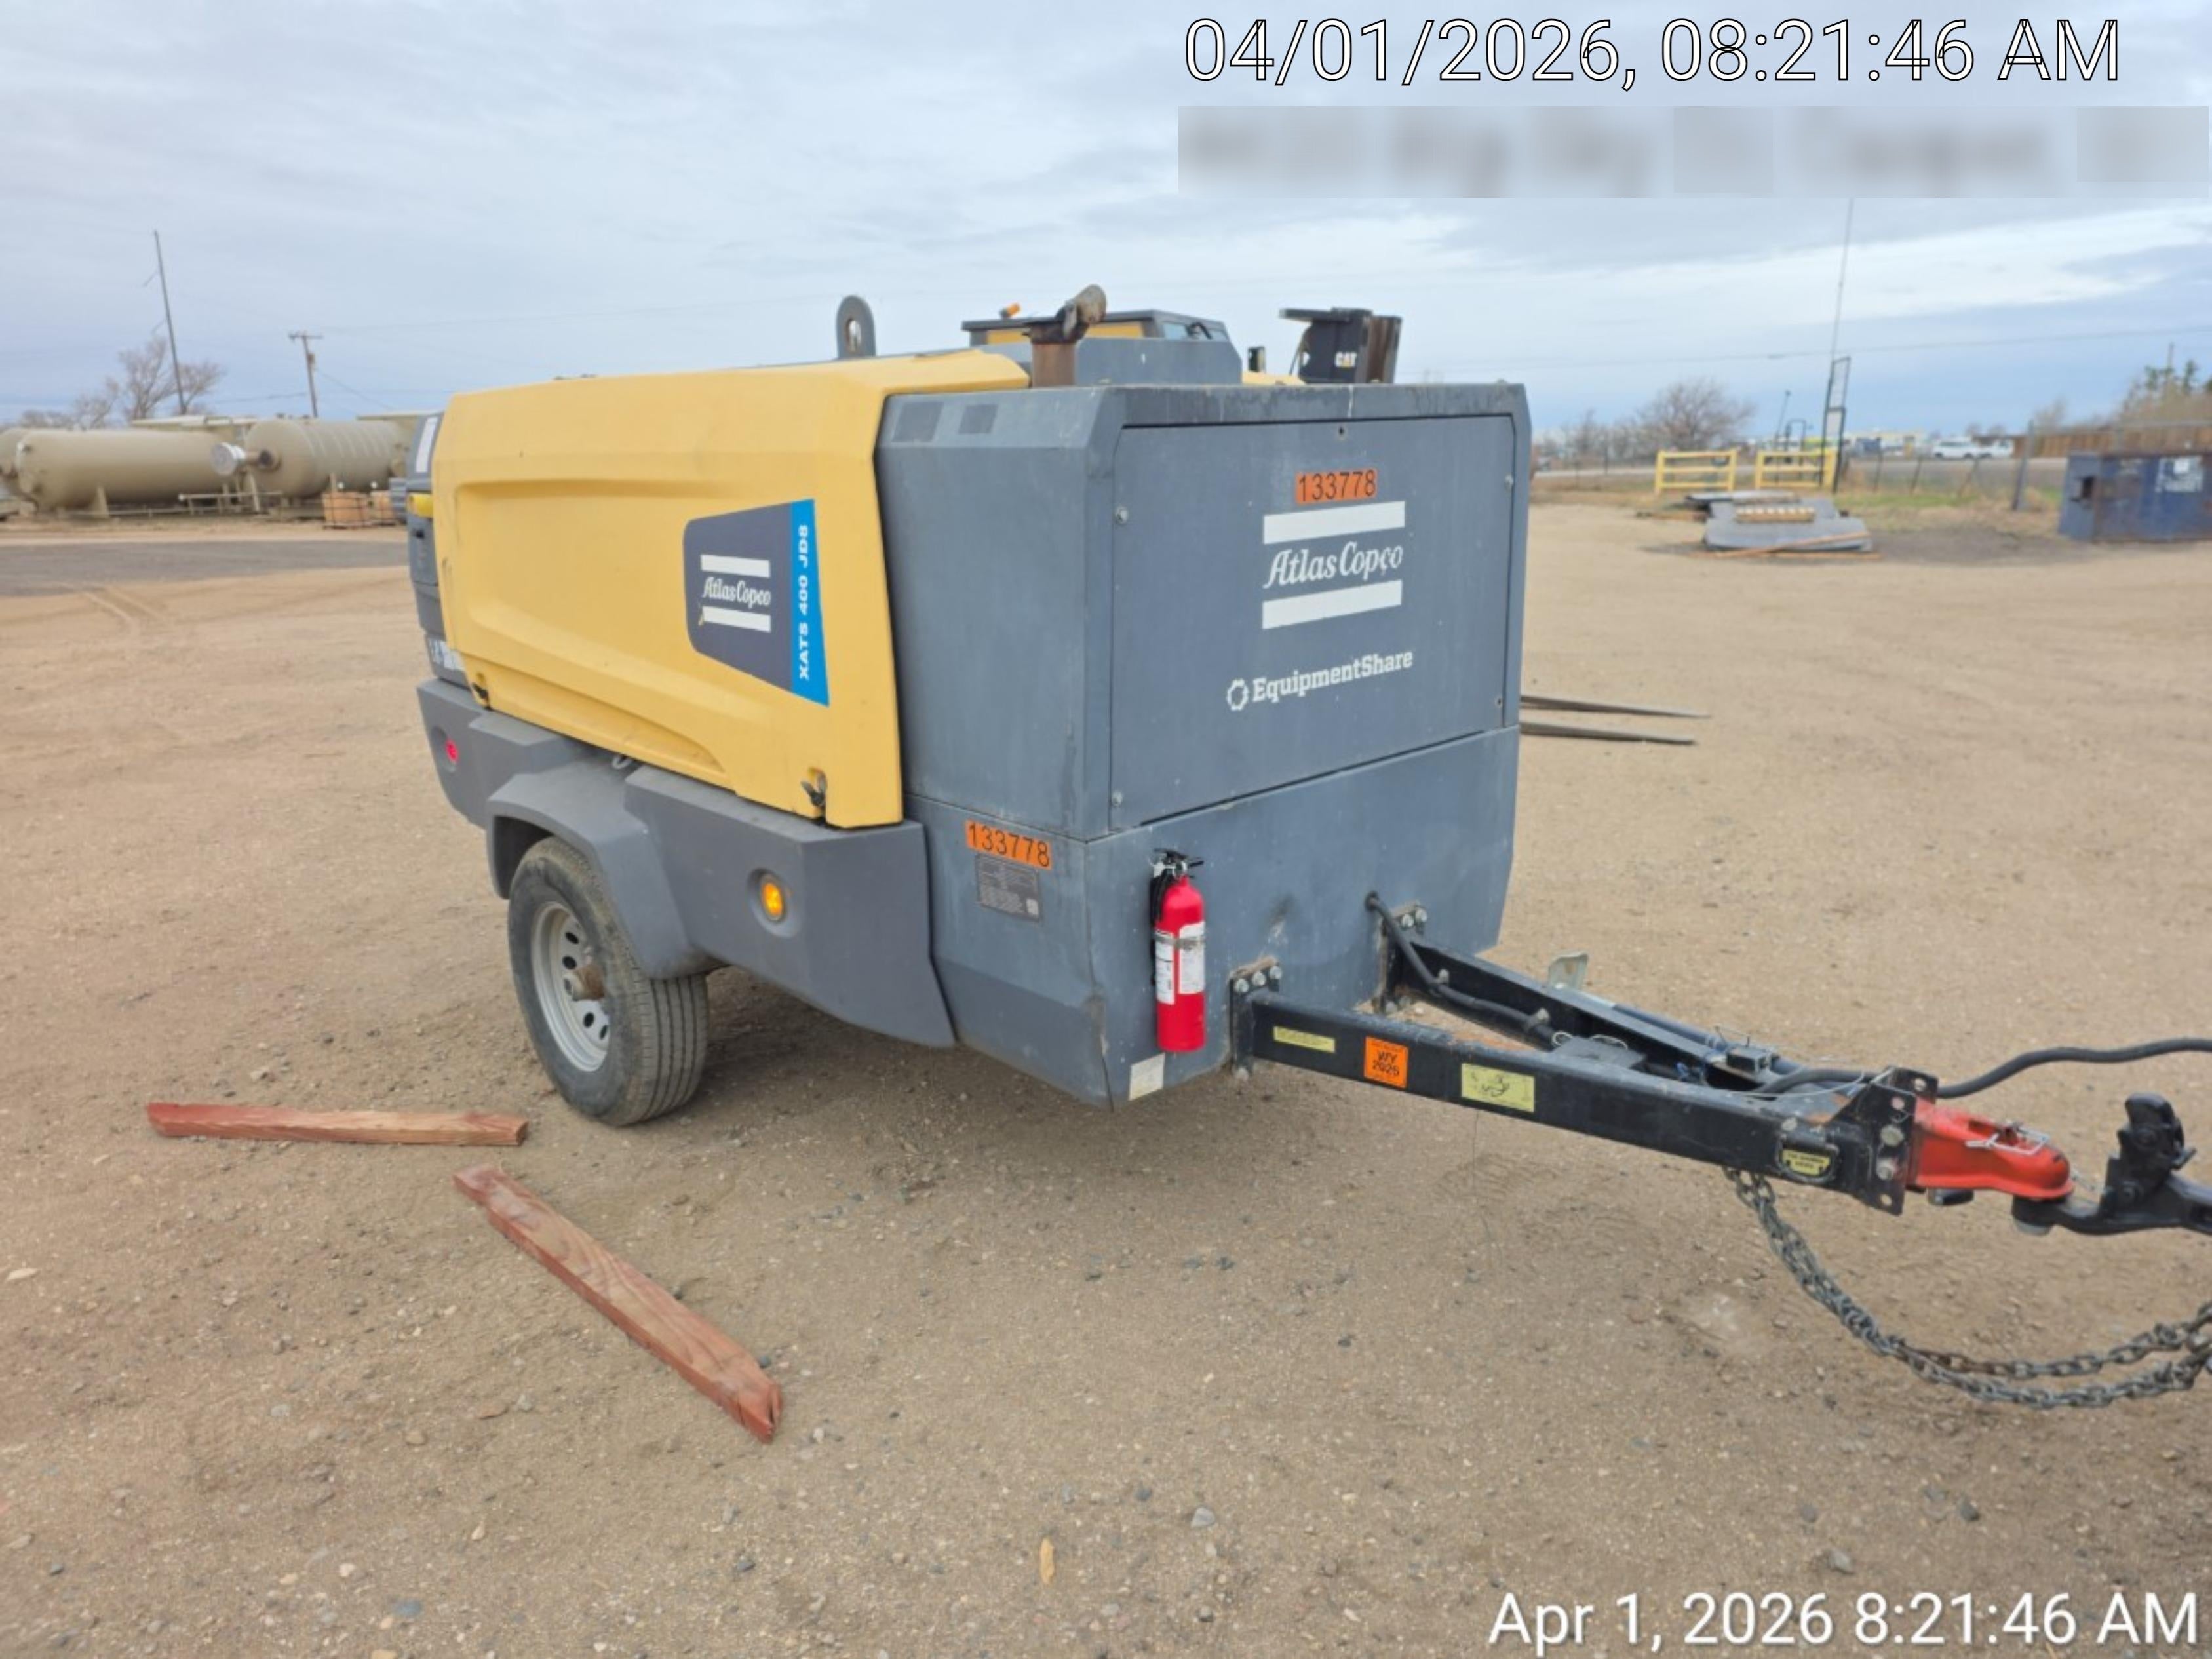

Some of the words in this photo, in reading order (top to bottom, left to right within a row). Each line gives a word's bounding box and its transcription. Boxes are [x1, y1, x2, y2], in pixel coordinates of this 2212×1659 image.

[1298, 469, 1376, 502] 133778
[1263, 549, 1337, 589] Atlas
[1339, 541, 1403, 581] Copco
[702, 576, 737, 602] Atlas
[736, 580, 771, 609] Copco
[798, 574, 808, 616] 400
[798, 621, 809, 680] XATS
[1252, 651, 1413, 703] EquipmentShare
[969, 822, 1050, 867] 133778
